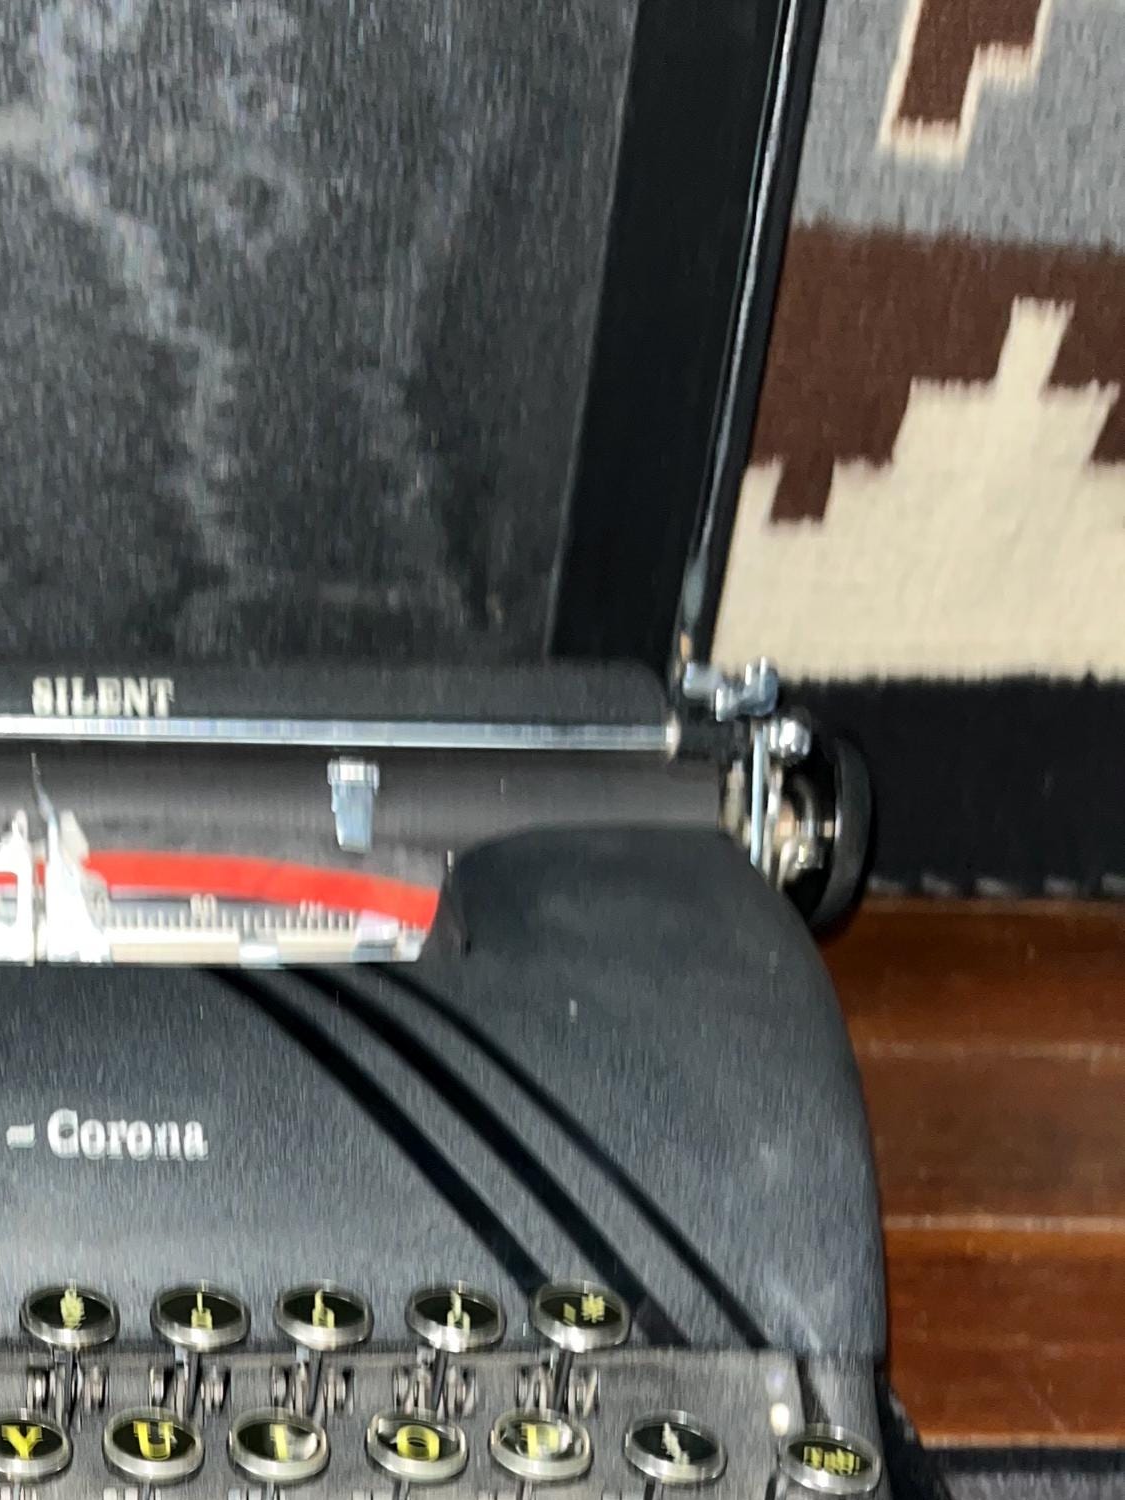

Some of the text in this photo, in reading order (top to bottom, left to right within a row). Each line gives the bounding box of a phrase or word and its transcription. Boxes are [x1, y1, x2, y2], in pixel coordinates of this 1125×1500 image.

[32, 676, 175, 717] SILENT
[47, 1108, 209, 1161] Corona
[1, 1424, 42, 1463] Y
[133, 1420, 174, 1461] U
[396, 1426, 440, 1463] O
